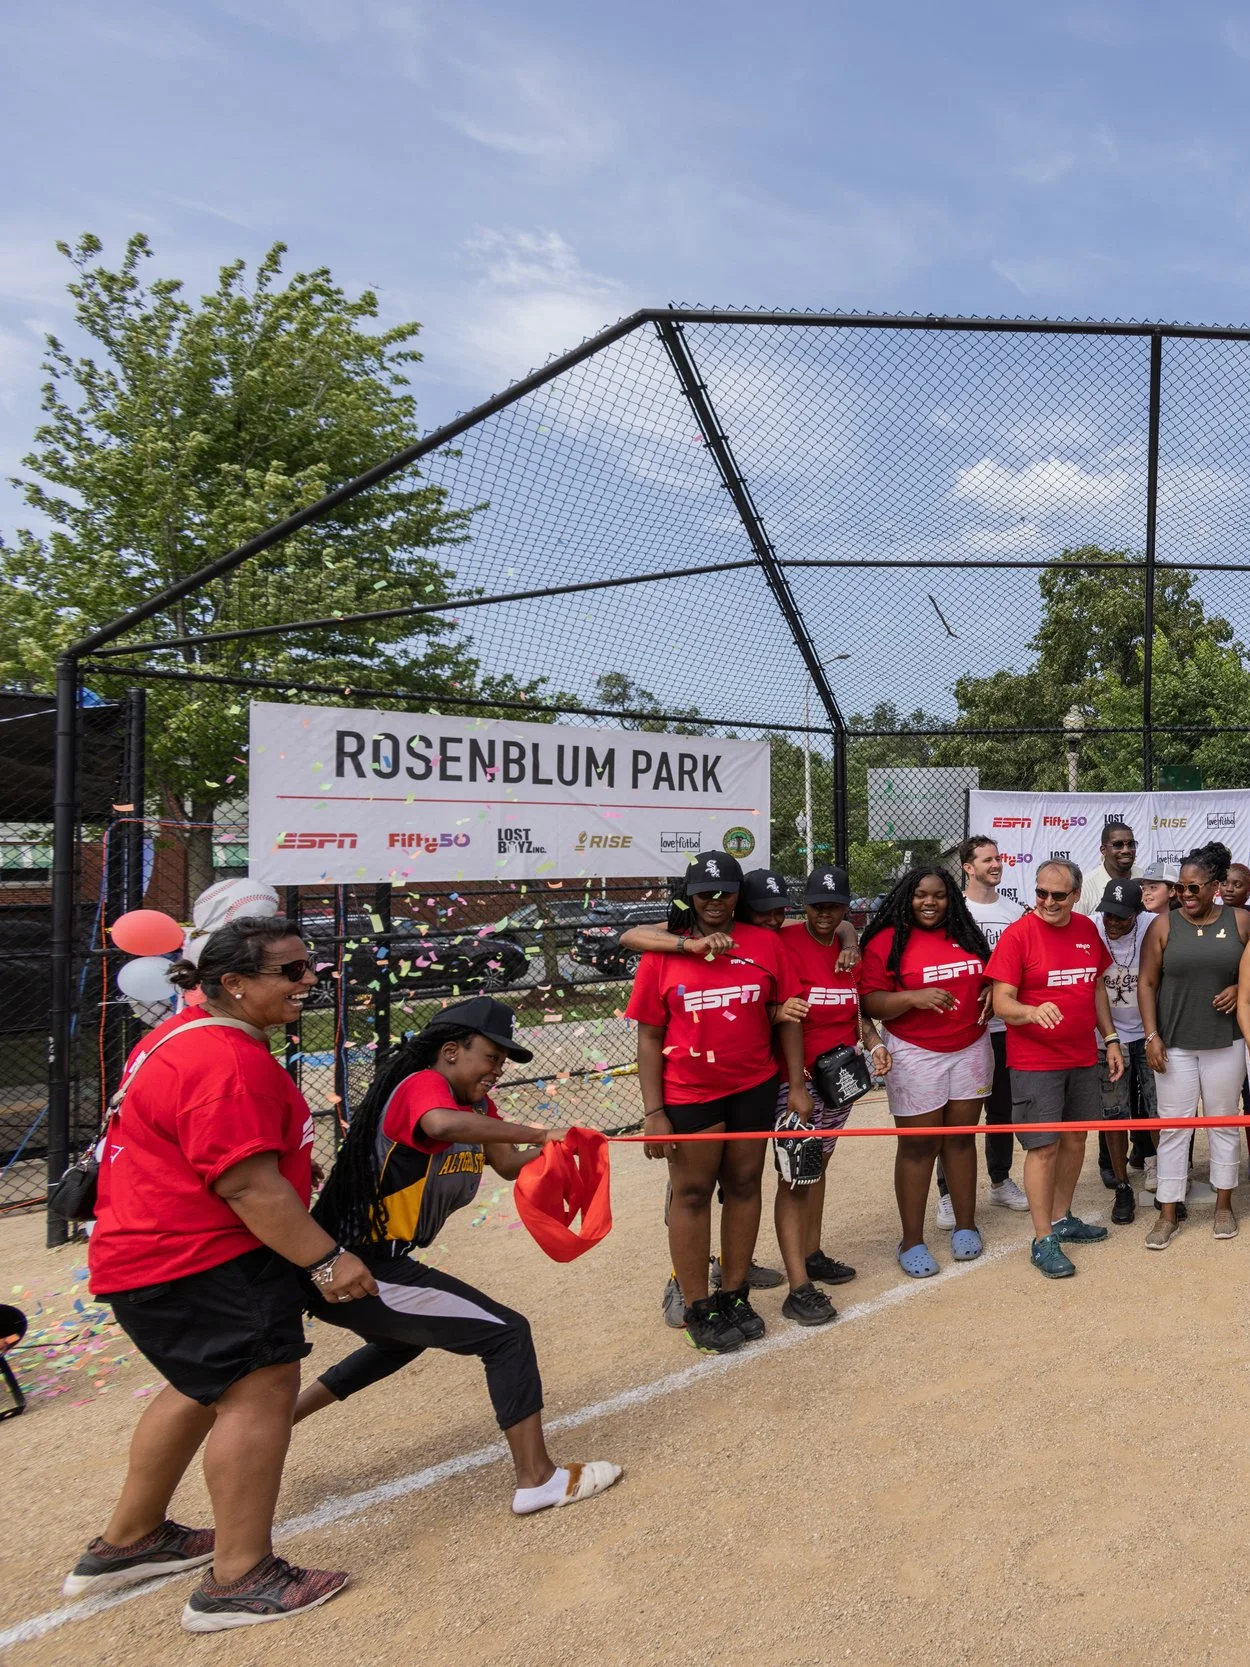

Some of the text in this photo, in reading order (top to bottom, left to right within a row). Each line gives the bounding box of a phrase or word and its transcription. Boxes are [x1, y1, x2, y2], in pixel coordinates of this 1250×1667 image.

[335, 730, 722, 793] ROSENBLUM PARK
[993, 817, 1031, 828] ESPN
[1043, 816, 1087, 830] Fifty50
[1105, 814, 1124, 823] LOST
[1160, 818, 1187, 828] RISE
[278, 833, 358, 849] ESPN
[498, 828, 531, 841] LOST
[388, 833, 470, 853] Fifty50
[589, 835, 632, 849] RISE
[1000, 853, 1033, 867] fty50
[922, 959, 983, 984] ESPN
[1047, 967, 1098, 987] ESPN
[684, 984, 761, 1013] ESPN
